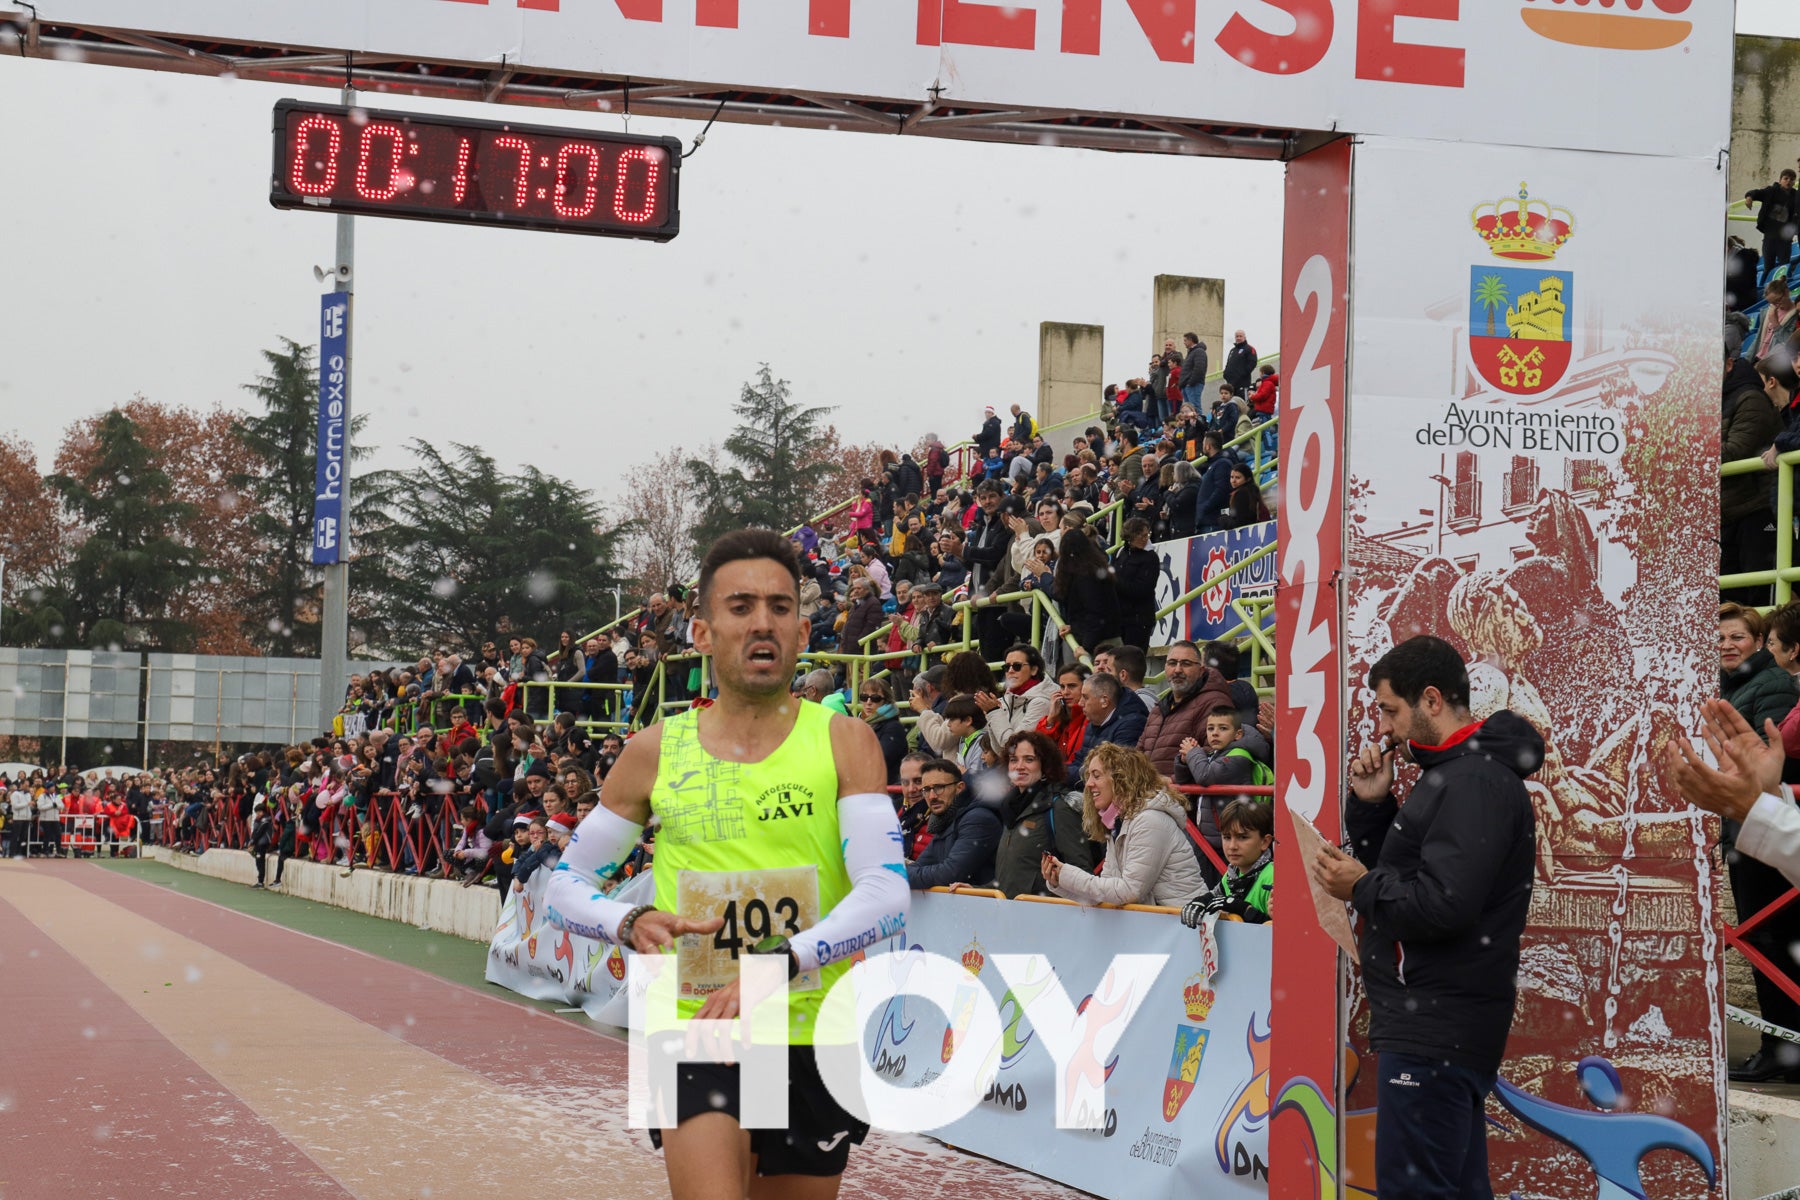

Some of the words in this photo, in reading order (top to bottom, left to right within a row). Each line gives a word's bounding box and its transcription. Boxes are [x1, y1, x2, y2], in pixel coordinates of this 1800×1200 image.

[292, 117, 659, 222] 00:17:00
[1443, 402, 1615, 431] Ayuntamiento
[1416, 423, 1512, 448] deDON
[1523, 427, 1619, 454] BENITO
[755, 783, 814, 806] AUTOESCUELA
[758, 802, 814, 821] JAVI
[714, 896, 800, 960] 493
[832, 927, 877, 959] ZURICH
[875, 1047, 907, 1078] DMD
